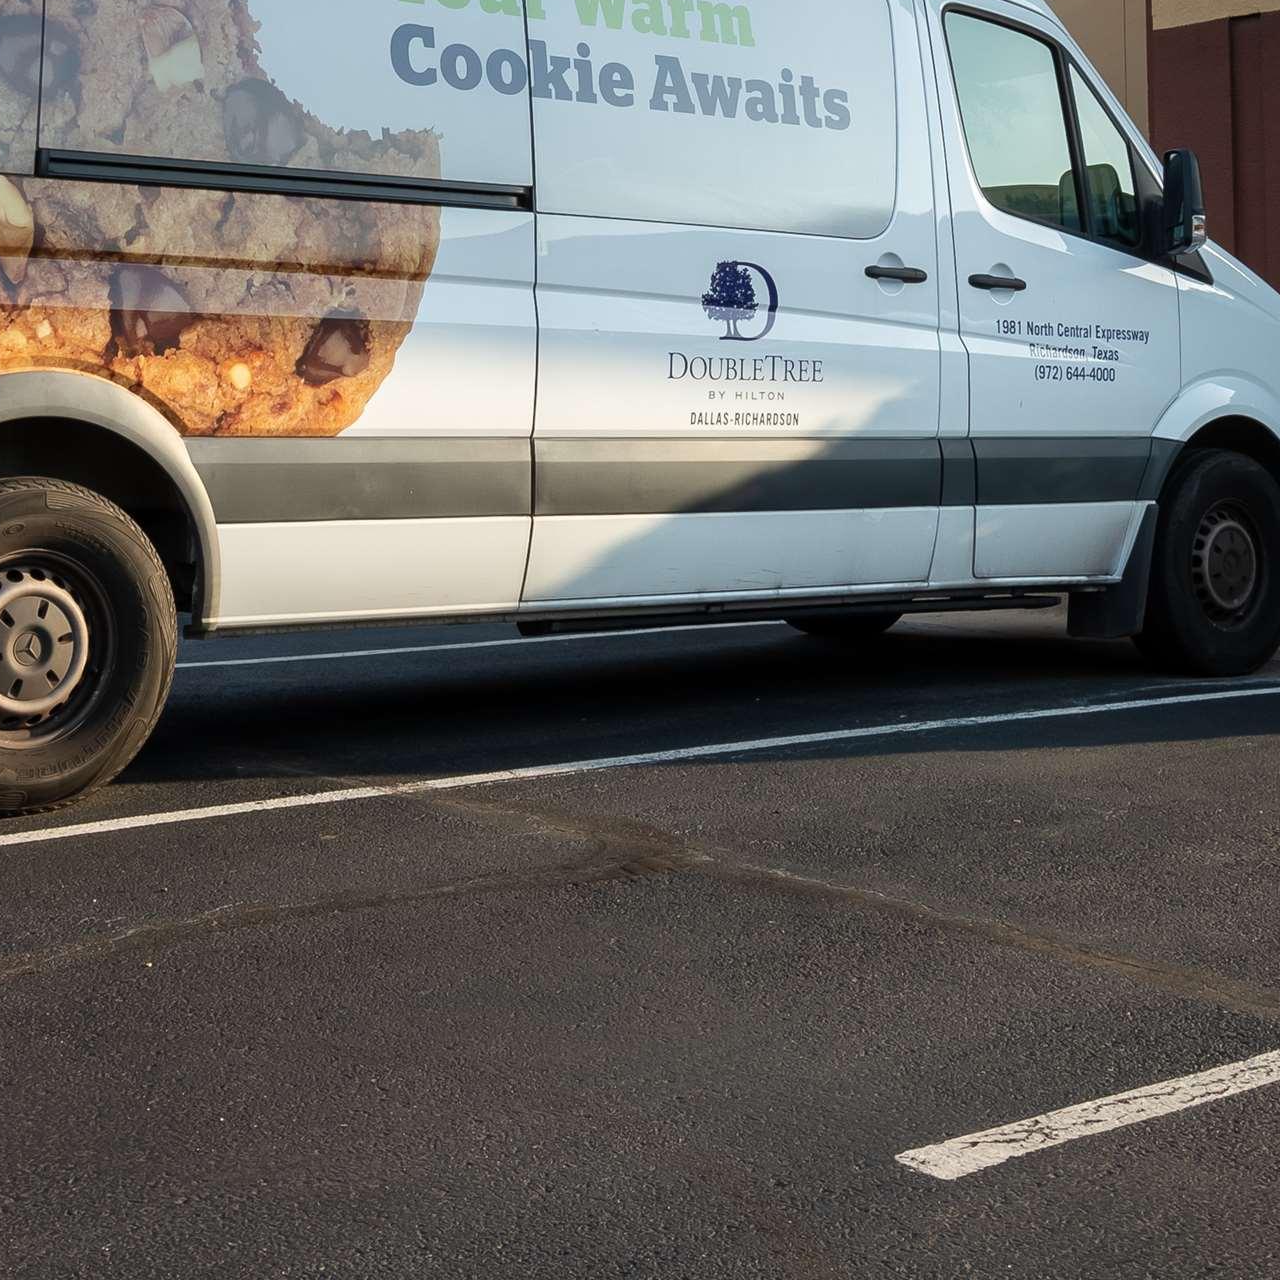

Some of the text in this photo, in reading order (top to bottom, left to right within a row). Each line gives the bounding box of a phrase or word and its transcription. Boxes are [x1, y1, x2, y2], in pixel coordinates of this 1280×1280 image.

[390, 23, 851, 131] Cookie Awaits
[996, 319, 1150, 344] 1981 North Central Expressway
[1092, 346, 1119, 361] Texas
[1034, 365, 1116, 382] (972) 644-4000
[708, 390, 786, 401] BY HILTON
[690, 411, 799, 426] DALLAS-RICHARDSON
